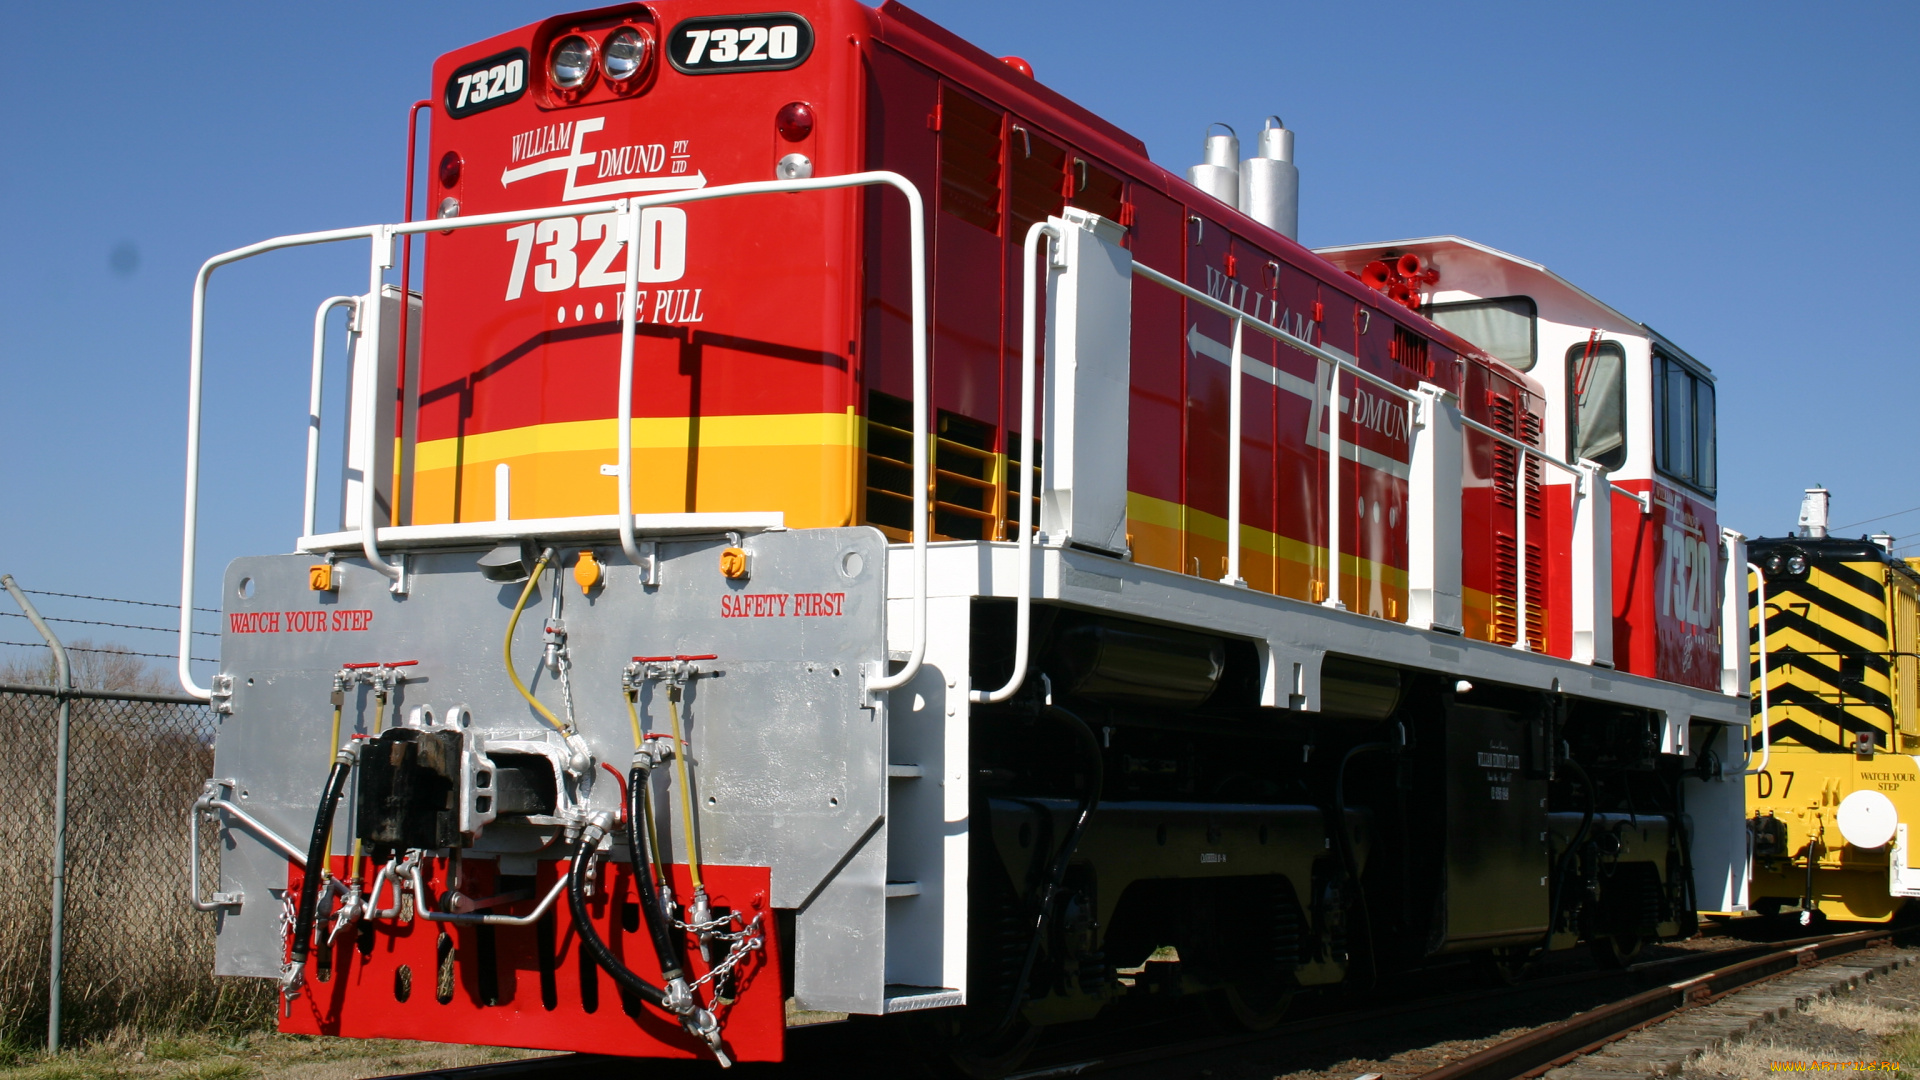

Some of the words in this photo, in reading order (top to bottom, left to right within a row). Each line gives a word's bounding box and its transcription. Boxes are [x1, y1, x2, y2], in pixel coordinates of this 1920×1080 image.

[685, 25, 798, 65] 7320
[456, 59, 524, 109] 7320
[511, 121, 573, 163] WILLIAM
[672, 140, 689, 154] PTY
[671, 160, 688, 174] LTD
[504, 206, 688, 301] 7320
[652, 288, 704, 324] PULL
[1662, 524, 1712, 629] 7320
[721, 593, 789, 618] SAFETY
[793, 592, 845, 617] FIRST
[230, 611, 281, 633] WATCH
[284, 610, 328, 632] YOUR
[331, 609, 373, 631] STEP
[1860, 771, 1890, 781] WATCH
[1892, 772, 1916, 782] YOUR
[1877, 783, 1900, 791] STEP
